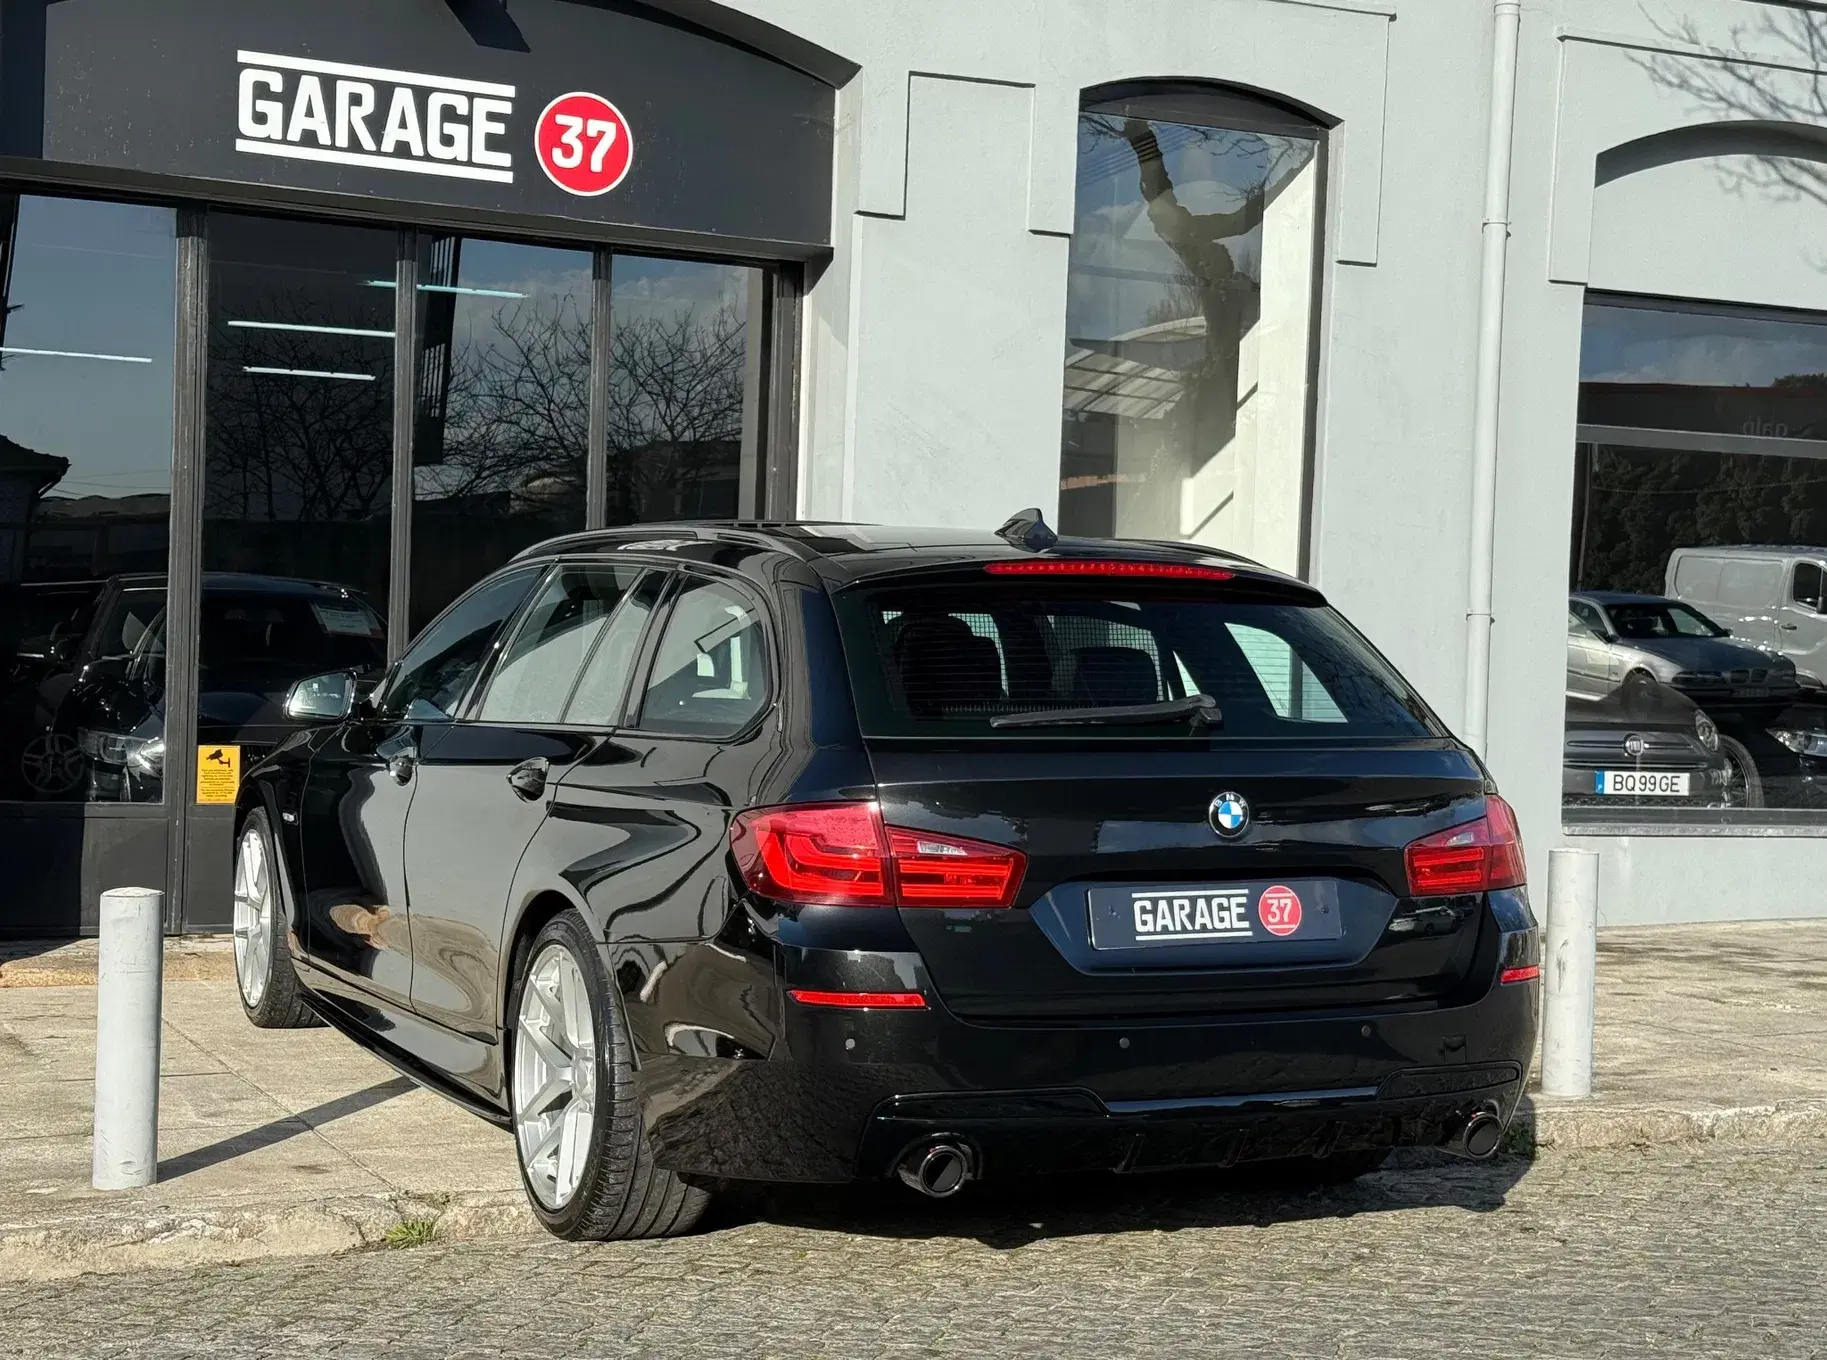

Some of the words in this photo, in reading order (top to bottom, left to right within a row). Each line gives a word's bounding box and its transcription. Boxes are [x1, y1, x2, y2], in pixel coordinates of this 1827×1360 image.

[238, 68, 513, 167] GARAGE
[551, 113, 617, 173] 37
[1213, 793, 1247, 808] BMW
[1133, 896, 1250, 933] GARAGE
[1267, 898, 1292, 925] 37
